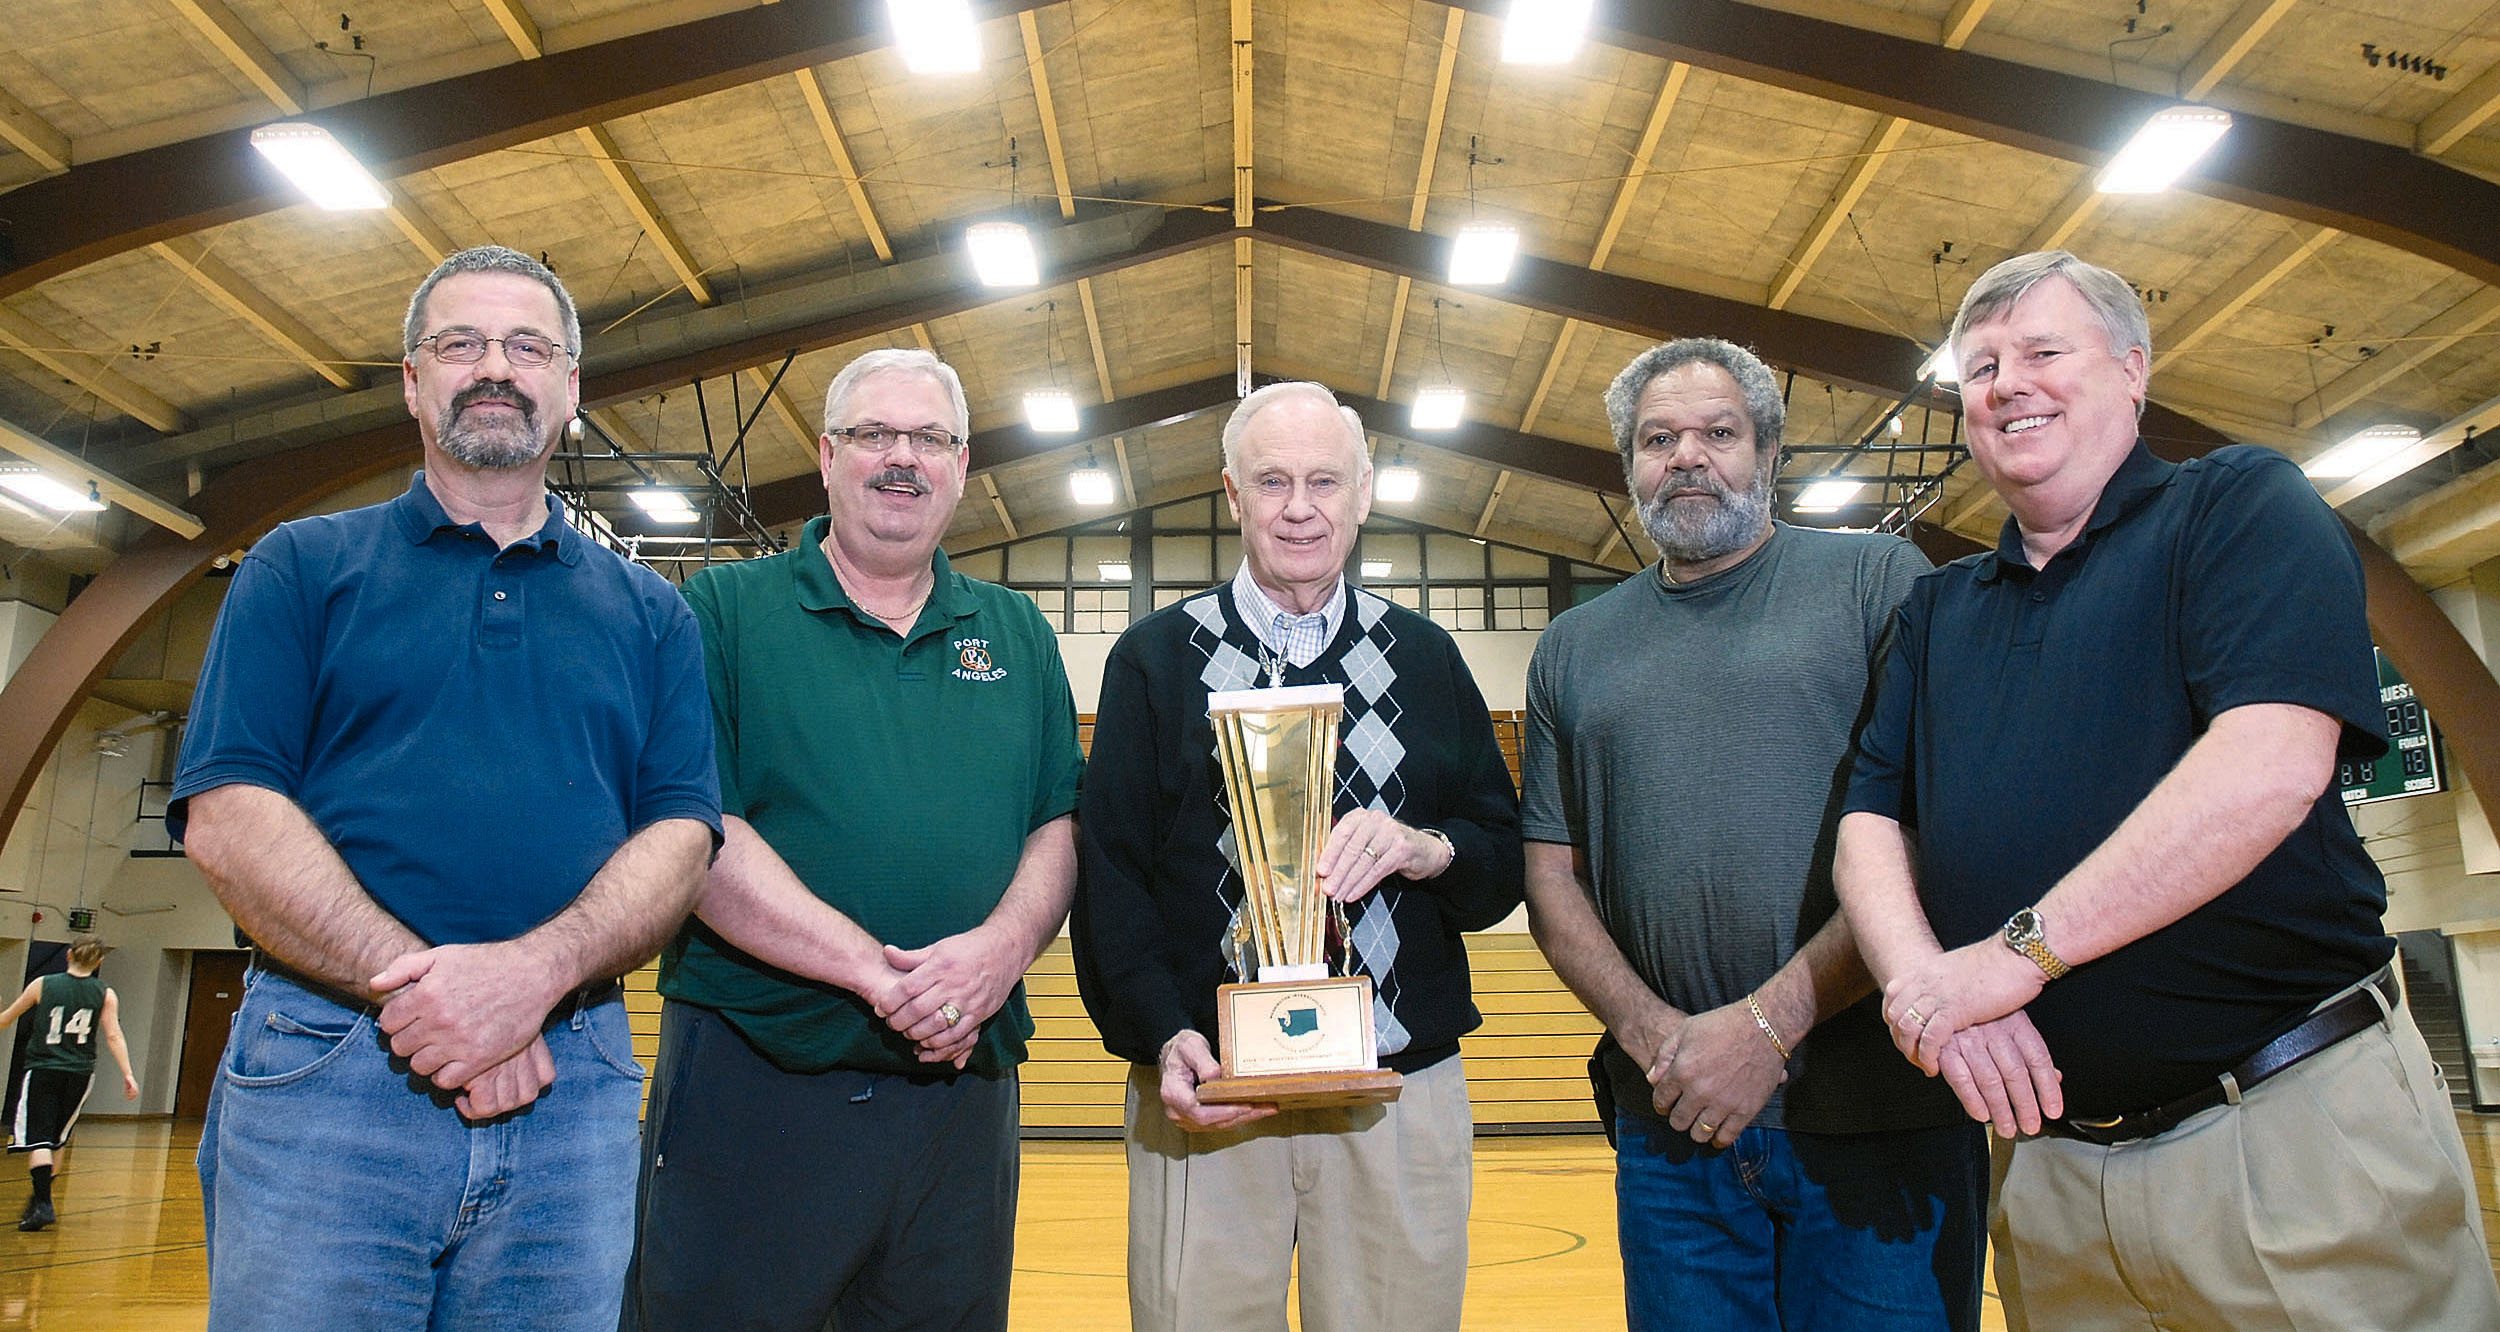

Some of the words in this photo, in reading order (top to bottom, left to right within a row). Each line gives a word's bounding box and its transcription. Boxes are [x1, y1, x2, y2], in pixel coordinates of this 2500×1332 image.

[954, 639, 989, 650] PORT
[952, 668, 1007, 681] ANGELES
[2399, 735, 2427, 749] FOULS
[2404, 777, 2434, 791] SCORE
[46, 1006, 93, 1044] 14
